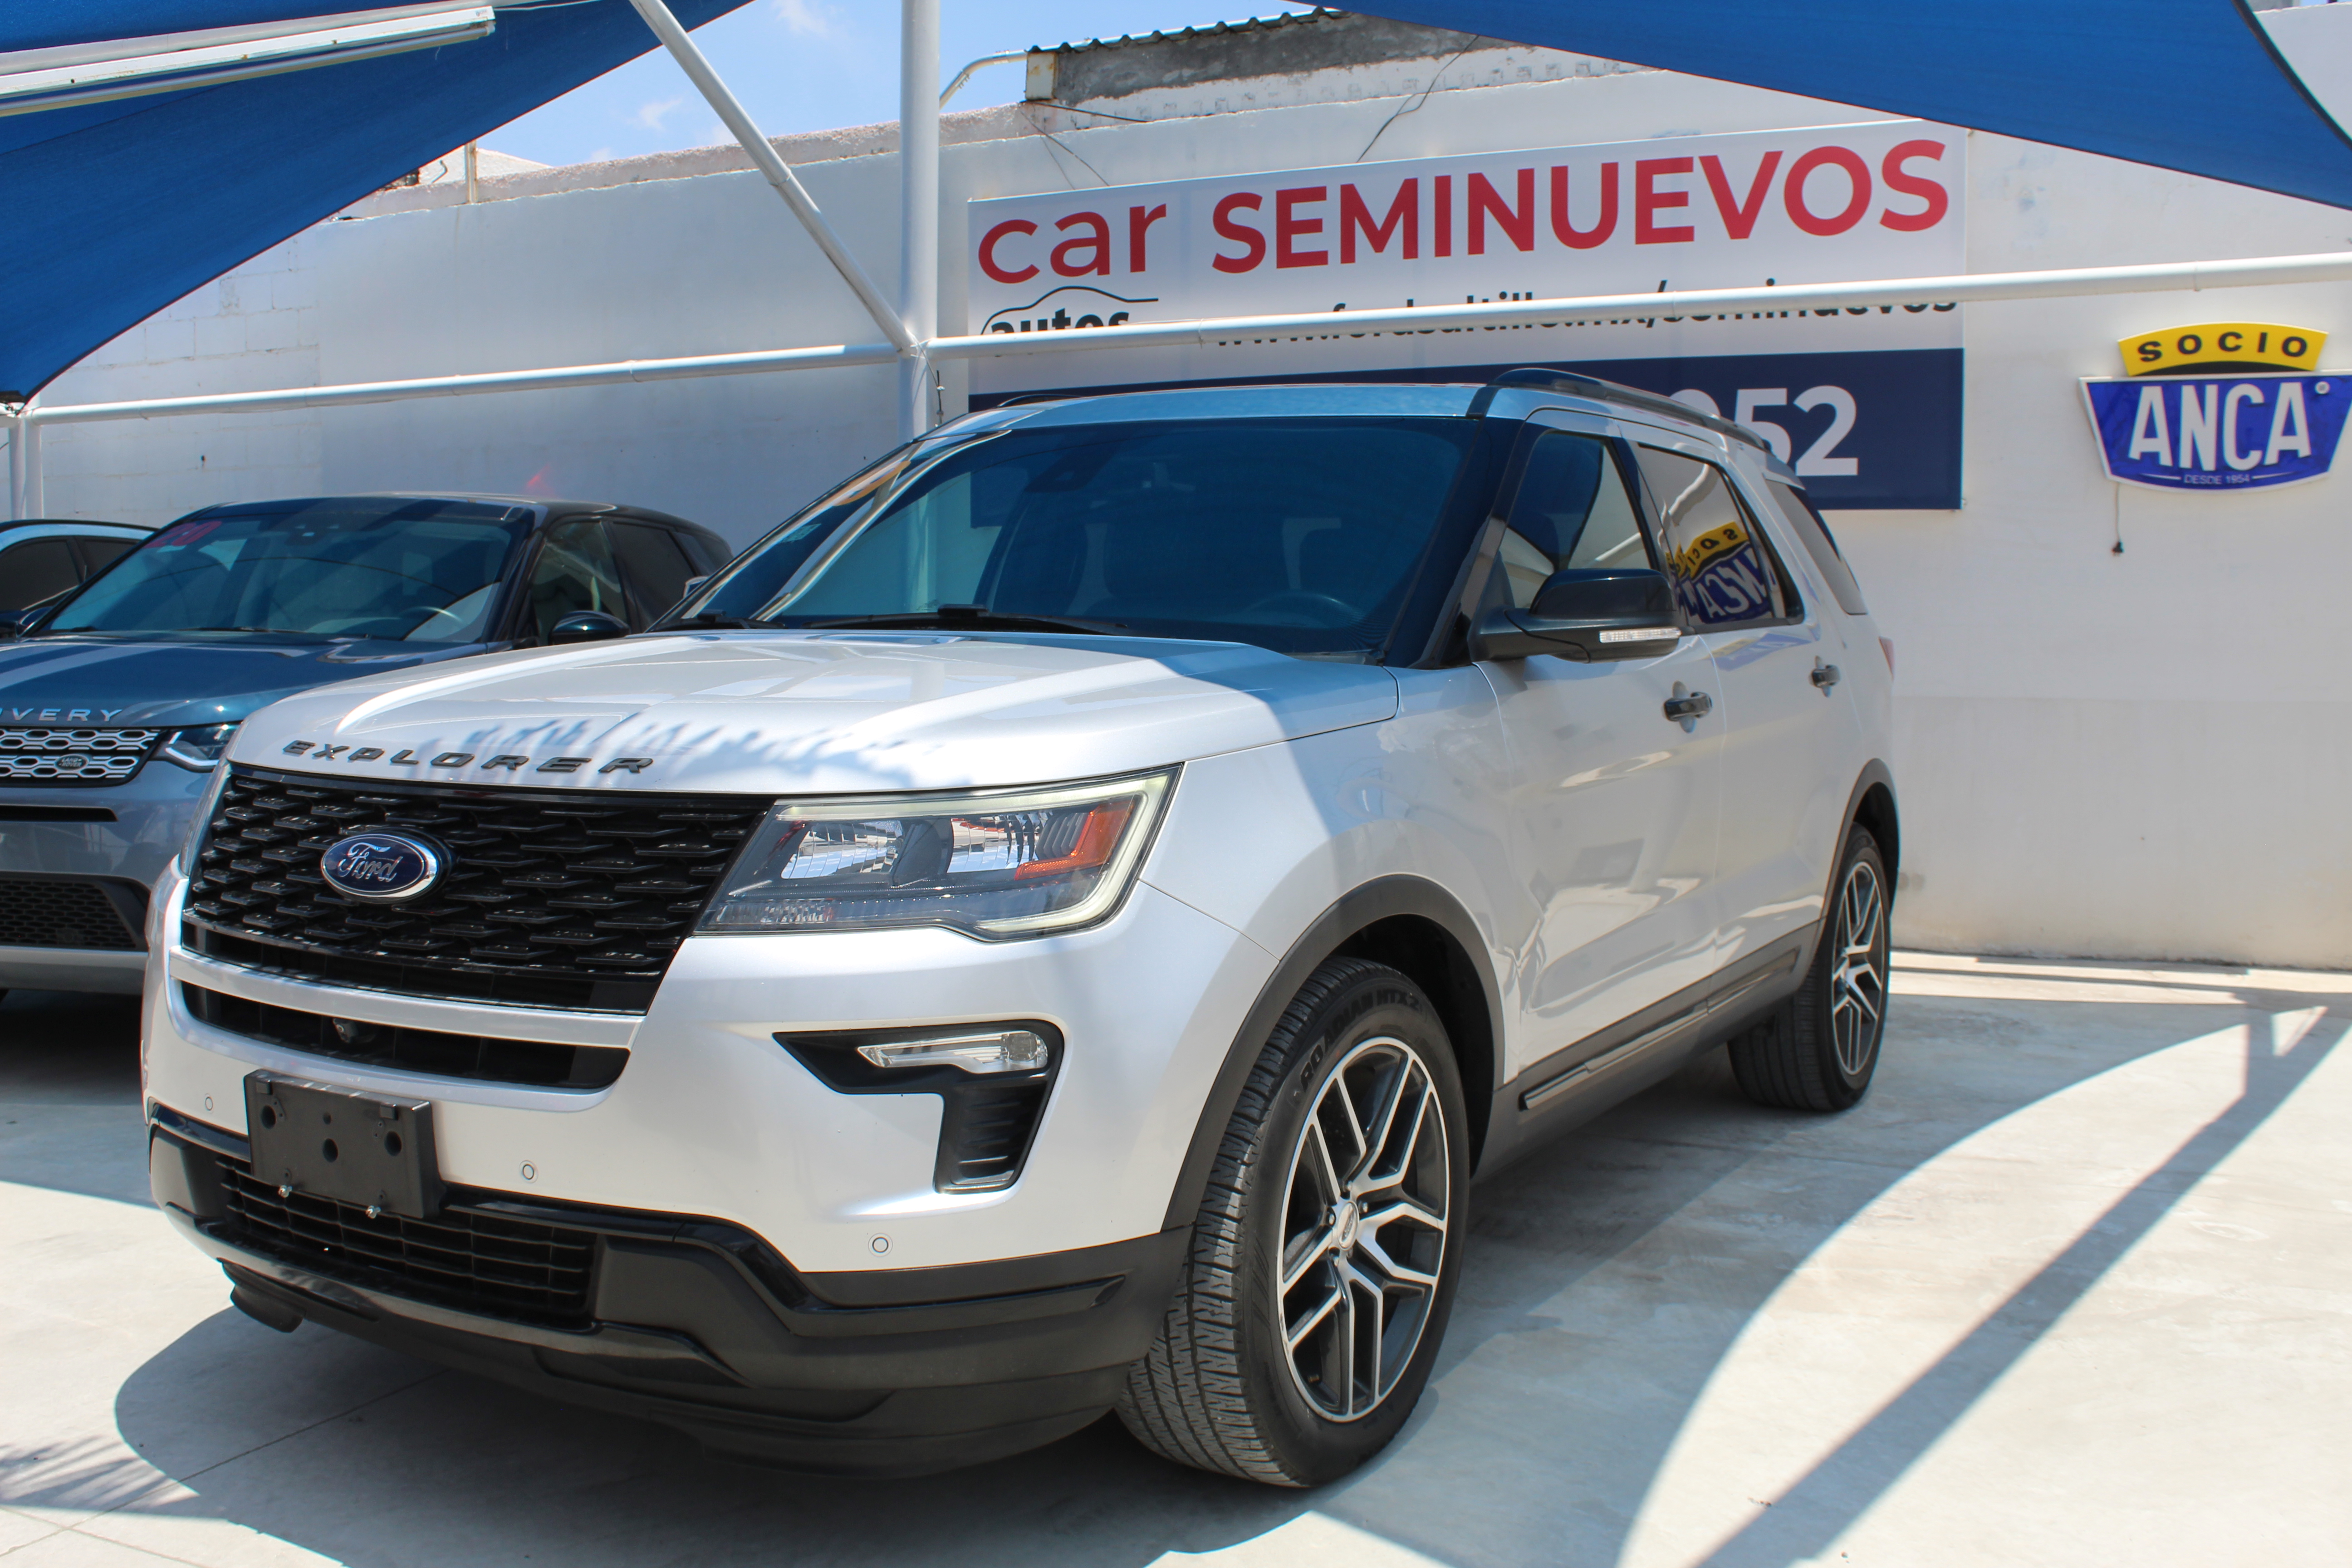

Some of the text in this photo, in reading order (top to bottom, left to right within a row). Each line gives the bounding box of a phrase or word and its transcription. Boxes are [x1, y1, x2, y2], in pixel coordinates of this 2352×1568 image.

[978, 139, 1950, 284] car SEMINUEVOS
[2137, 331, 2308, 362] SOCIO
[2128, 382, 2312, 471] ANCA
[2184, 474, 2223, 485] DESDE
[283, 740, 654, 774] EXPLORER
[338, 842, 403, 882] Ford
